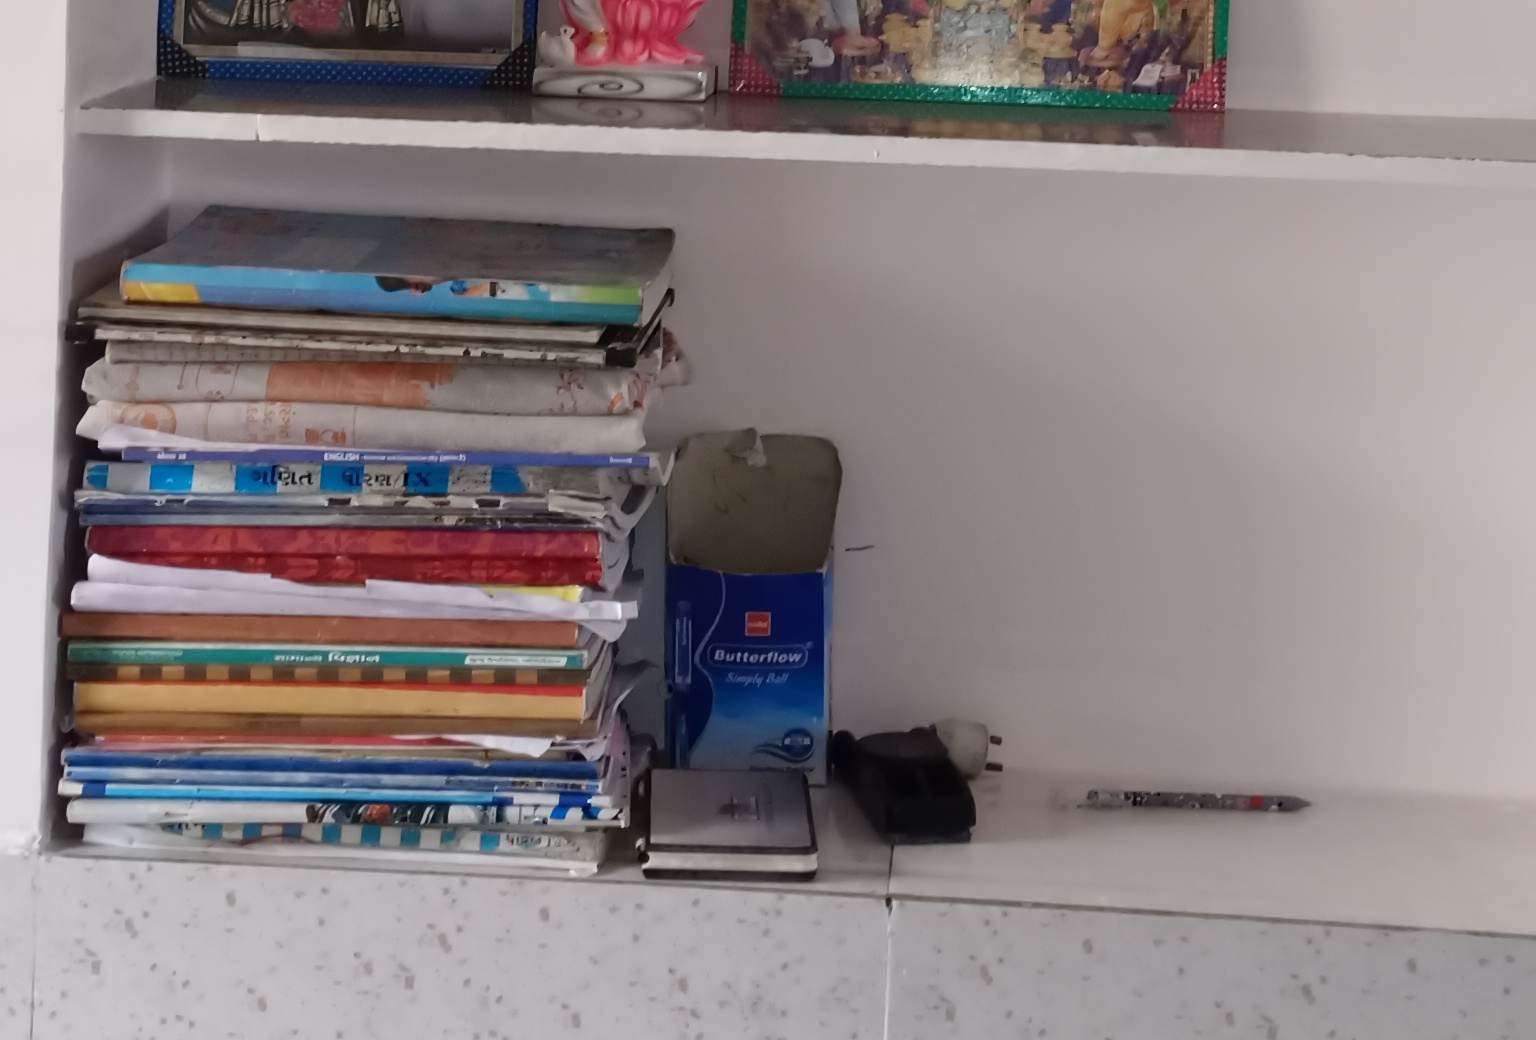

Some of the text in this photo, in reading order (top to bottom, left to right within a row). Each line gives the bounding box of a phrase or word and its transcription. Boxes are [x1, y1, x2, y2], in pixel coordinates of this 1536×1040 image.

[323, 452, 360, 462] ENGLISH
[713, 649, 803, 664] Butterflow
[724, 671, 790, 688] Simply Ball
